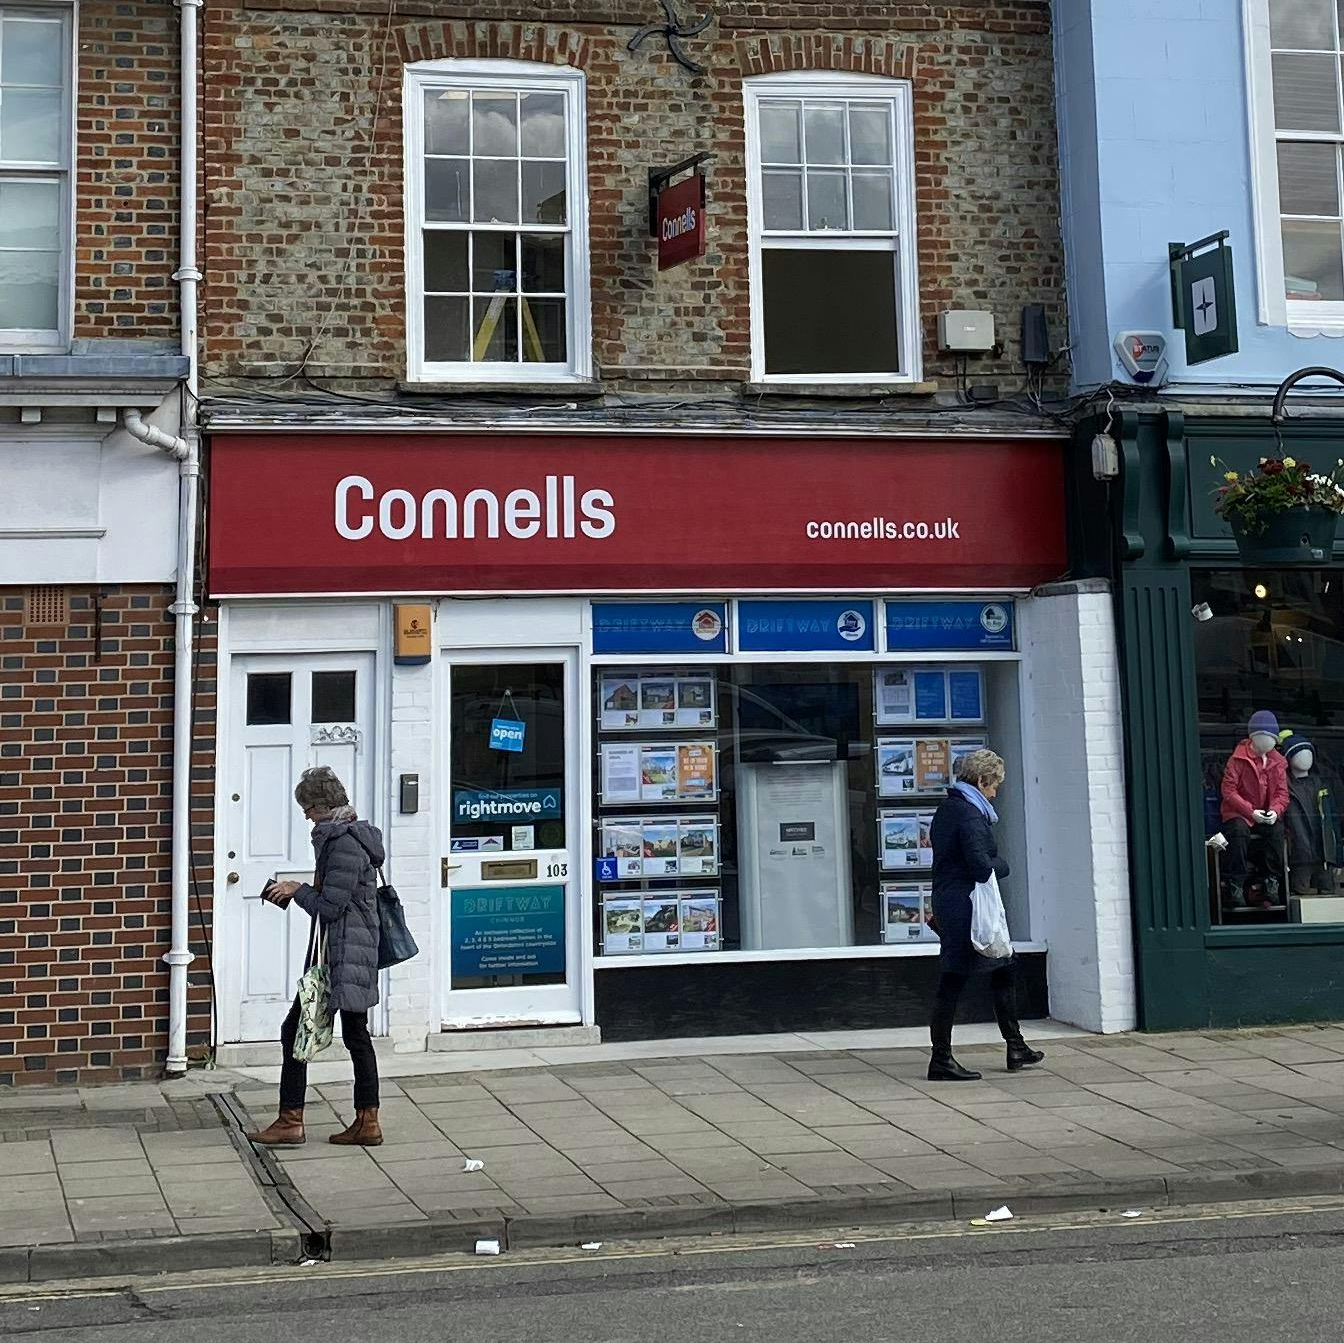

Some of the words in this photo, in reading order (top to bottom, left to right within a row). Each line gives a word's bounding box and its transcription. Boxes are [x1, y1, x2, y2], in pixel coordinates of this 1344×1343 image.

[662, 206, 696, 241] Connells
[335, 475, 616, 540] Connells
[806, 517, 960, 539] connells.co.uk
[493, 728, 523, 740] open
[459, 800, 542, 818] rightmove
[547, 864, 567, 877] 103
[464, 896, 552, 913] DRIFTWAY
